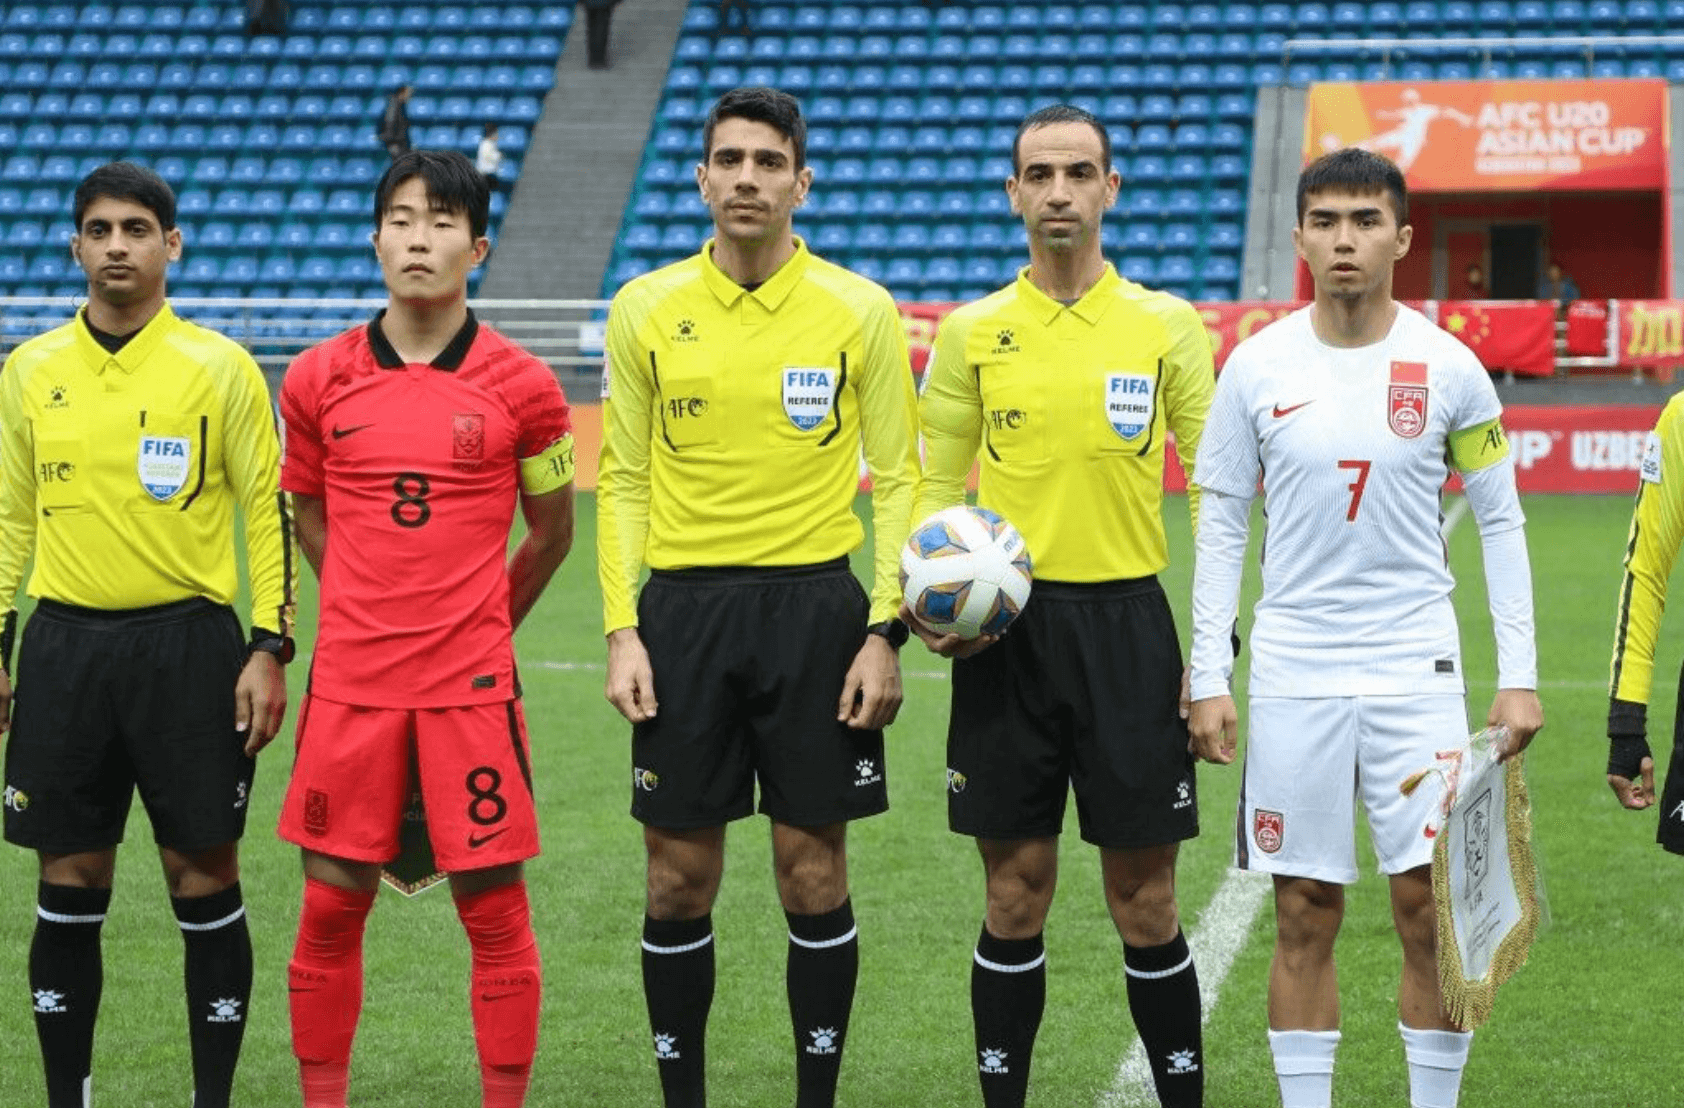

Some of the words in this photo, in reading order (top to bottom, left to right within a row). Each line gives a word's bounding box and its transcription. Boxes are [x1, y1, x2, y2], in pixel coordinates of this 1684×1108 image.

[1478, 102, 1540, 129] AFC
[1548, 101, 1608, 129] U20
[1477, 131, 1573, 156] ASIAN
[1577, 129, 1645, 156] CUP
[787, 373, 829, 387] FIFA
[1110, 378, 1149, 395] FIFA
[788, 397, 829, 405] REFEREE
[1109, 403, 1149, 414] REFEREE
[143, 440, 185, 457] FIFA
[1337, 460, 1371, 522] 7
[391, 472, 431, 529] 8
[854, 774, 882, 787] KELME
[466, 766, 507, 826] 8
